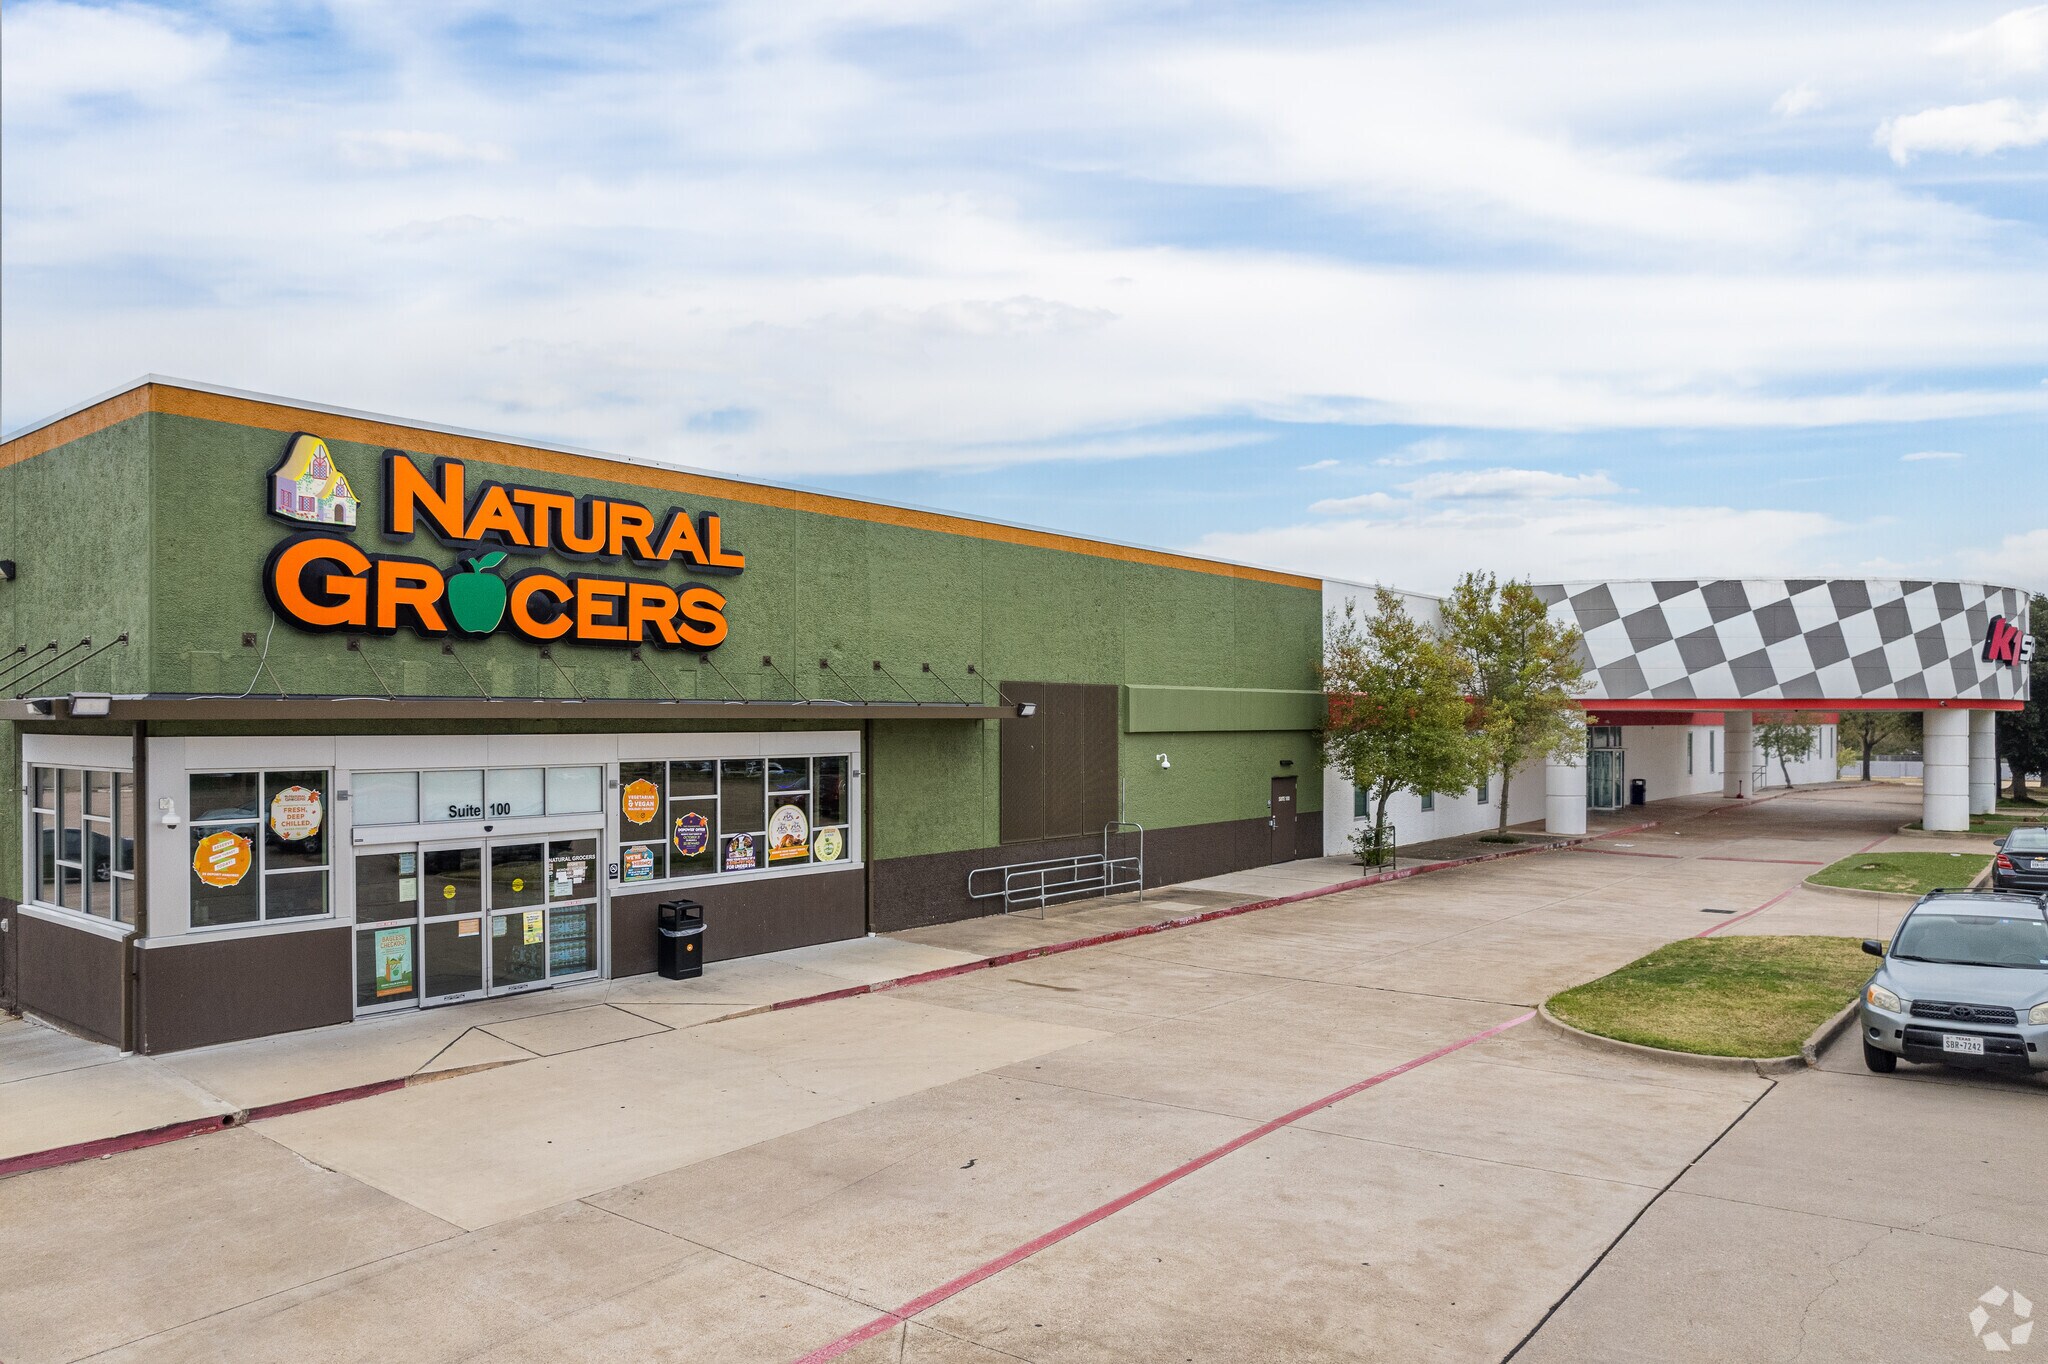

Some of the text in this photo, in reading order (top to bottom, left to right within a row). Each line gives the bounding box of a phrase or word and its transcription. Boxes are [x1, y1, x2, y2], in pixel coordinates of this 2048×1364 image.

[393, 455, 745, 572] NATURAL
[275, 538, 728, 647] GROCERS
[448, 802, 511, 818] Suite 100
[380, 940, 407, 949] CHECKOUT
[381, 934, 406, 943] BAGLESS
[1945, 1041, 1981, 1051] SBR-7242
